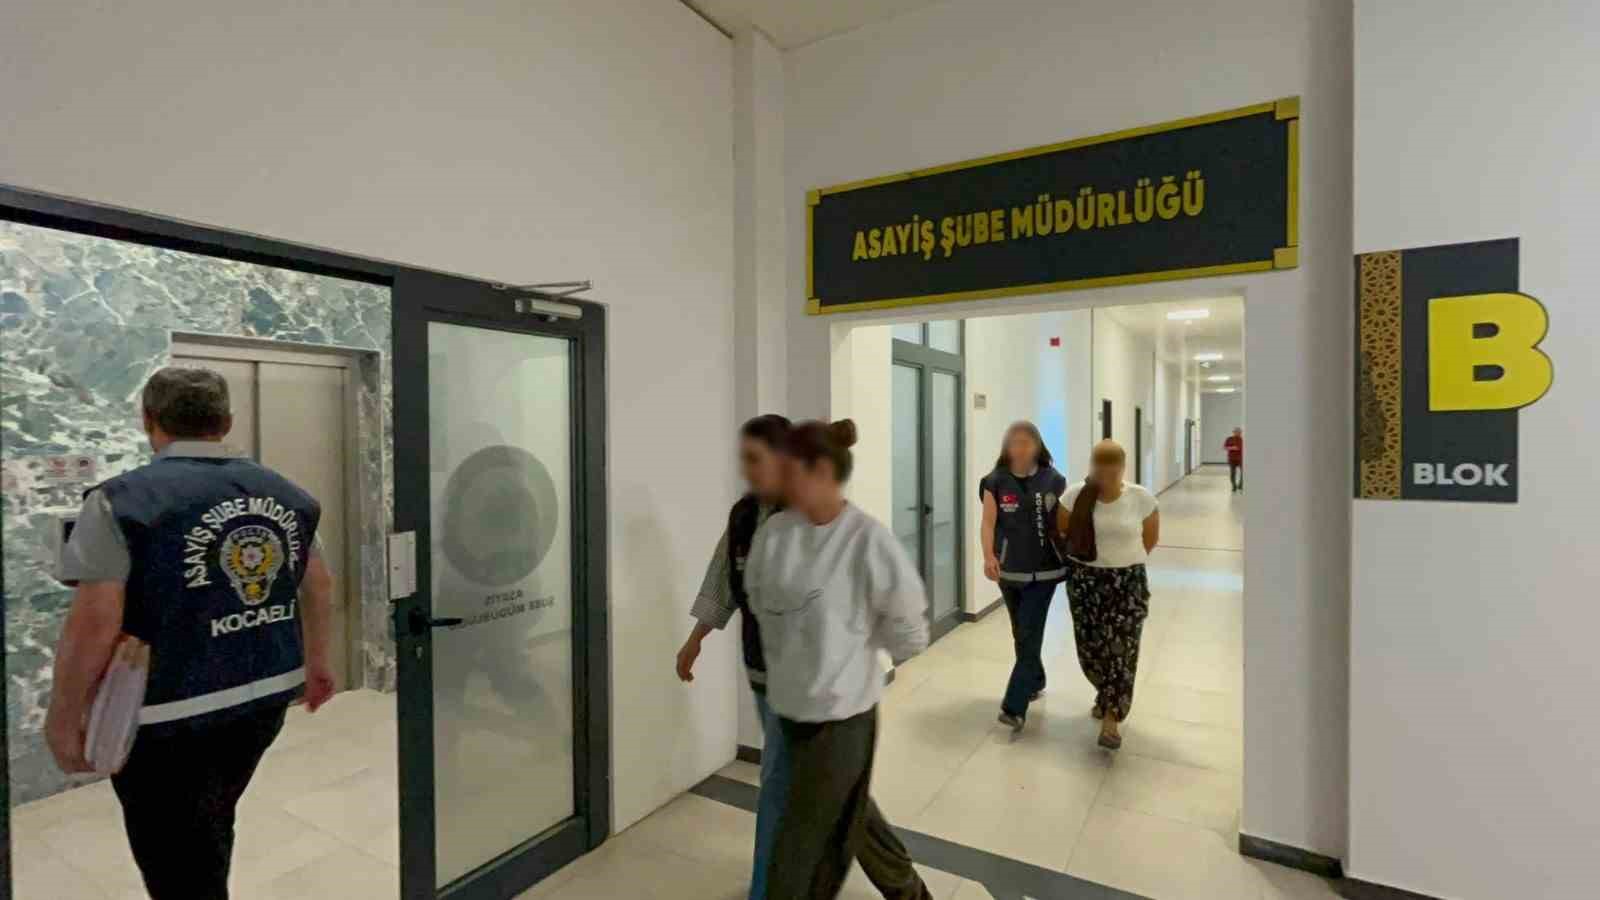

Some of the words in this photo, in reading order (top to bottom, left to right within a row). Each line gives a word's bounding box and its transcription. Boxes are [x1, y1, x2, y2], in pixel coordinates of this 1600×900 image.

[852, 214, 934, 261] ASAYİŞ
[940, 208, 1006, 259] ŞUBE
[1011, 169, 1206, 240] MÜDÜRLÜĞÜ
[1427, 291, 1554, 413] B
[1412, 462, 1510, 487] BLOK
[201, 498, 247, 532] ŞUBE
[210, 599, 297, 638] KOCAELİ
